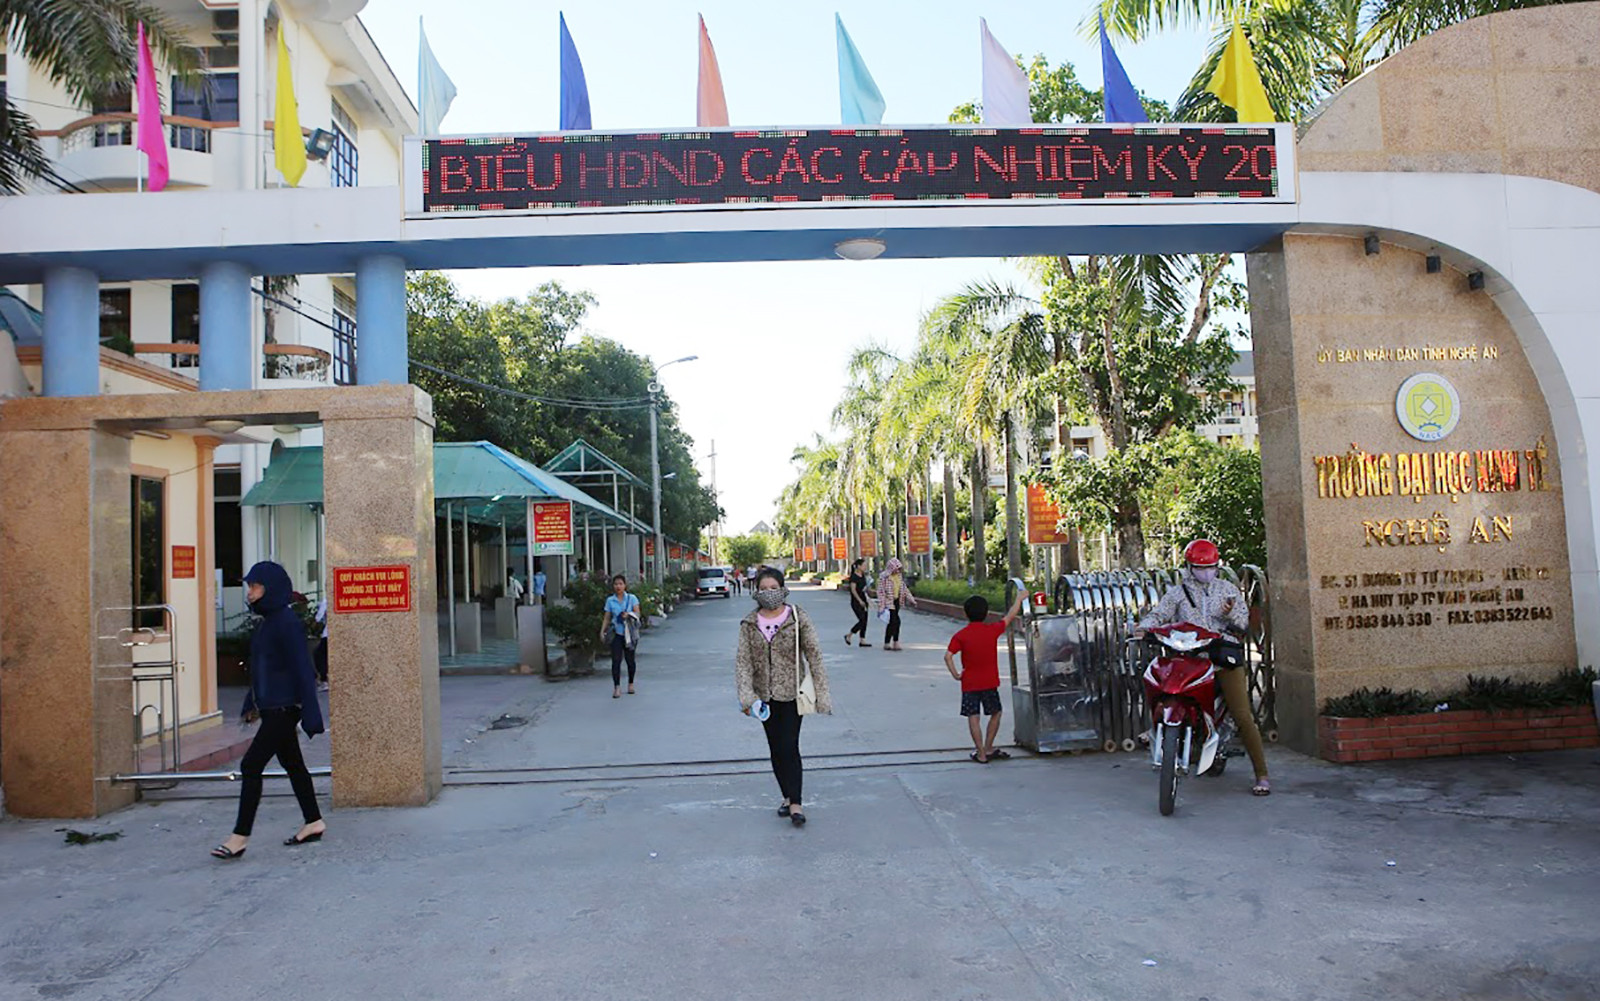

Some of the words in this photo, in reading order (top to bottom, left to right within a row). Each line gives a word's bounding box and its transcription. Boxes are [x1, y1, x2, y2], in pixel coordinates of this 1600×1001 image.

[440, 142, 562, 194] BIỂU
[578, 149, 725, 189] HĐND
[740, 139, 843, 186] CÁC
[973, 136, 1133, 190] NHIỆM
[1147, 136, 1207, 180] KỲ
[1337, 349, 1361, 363] BAN
[1482, 346, 1498, 360] AN
[1313, 441, 1394, 498] TRƯỜNG
[1397, 452, 1431, 503] ĐẠI
[1433, 450, 1473, 503] HỌC
[1362, 511, 1452, 553] NGHỆ
[1468, 515, 1513, 544] AN
[354, 572, 374, 580] KHÁCH
[376, 572, 386, 580] VUI
[366, 585, 374, 593] XE
[1370, 594, 1395, 608] HUY
[1505, 588, 1524, 602] AN
